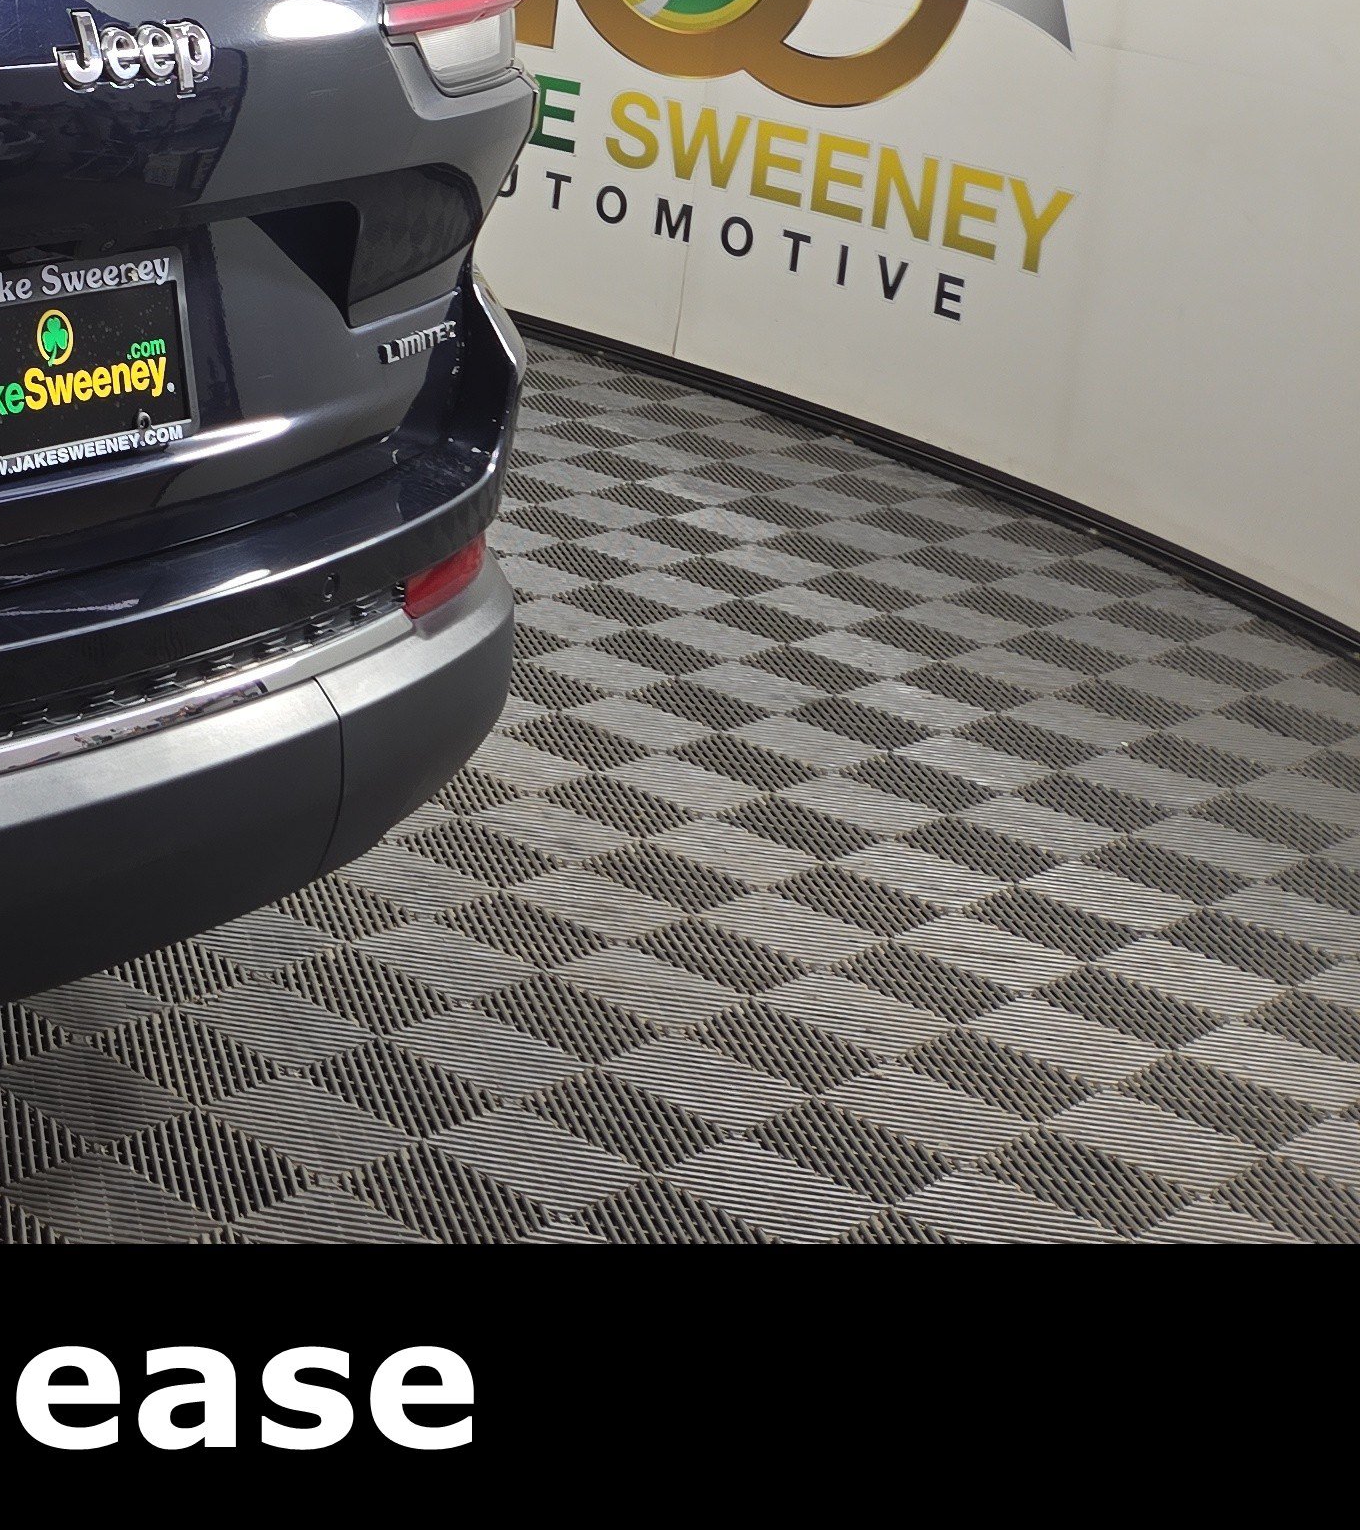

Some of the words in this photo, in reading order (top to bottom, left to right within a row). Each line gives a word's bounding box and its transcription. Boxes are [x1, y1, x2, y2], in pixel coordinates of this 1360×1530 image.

[53, 8, 213, 97] Jeep
[605, 91, 1074, 274] SWEENEY
[41, 258, 169, 295] Sweeney
[127, 339, 165, 359] .com
